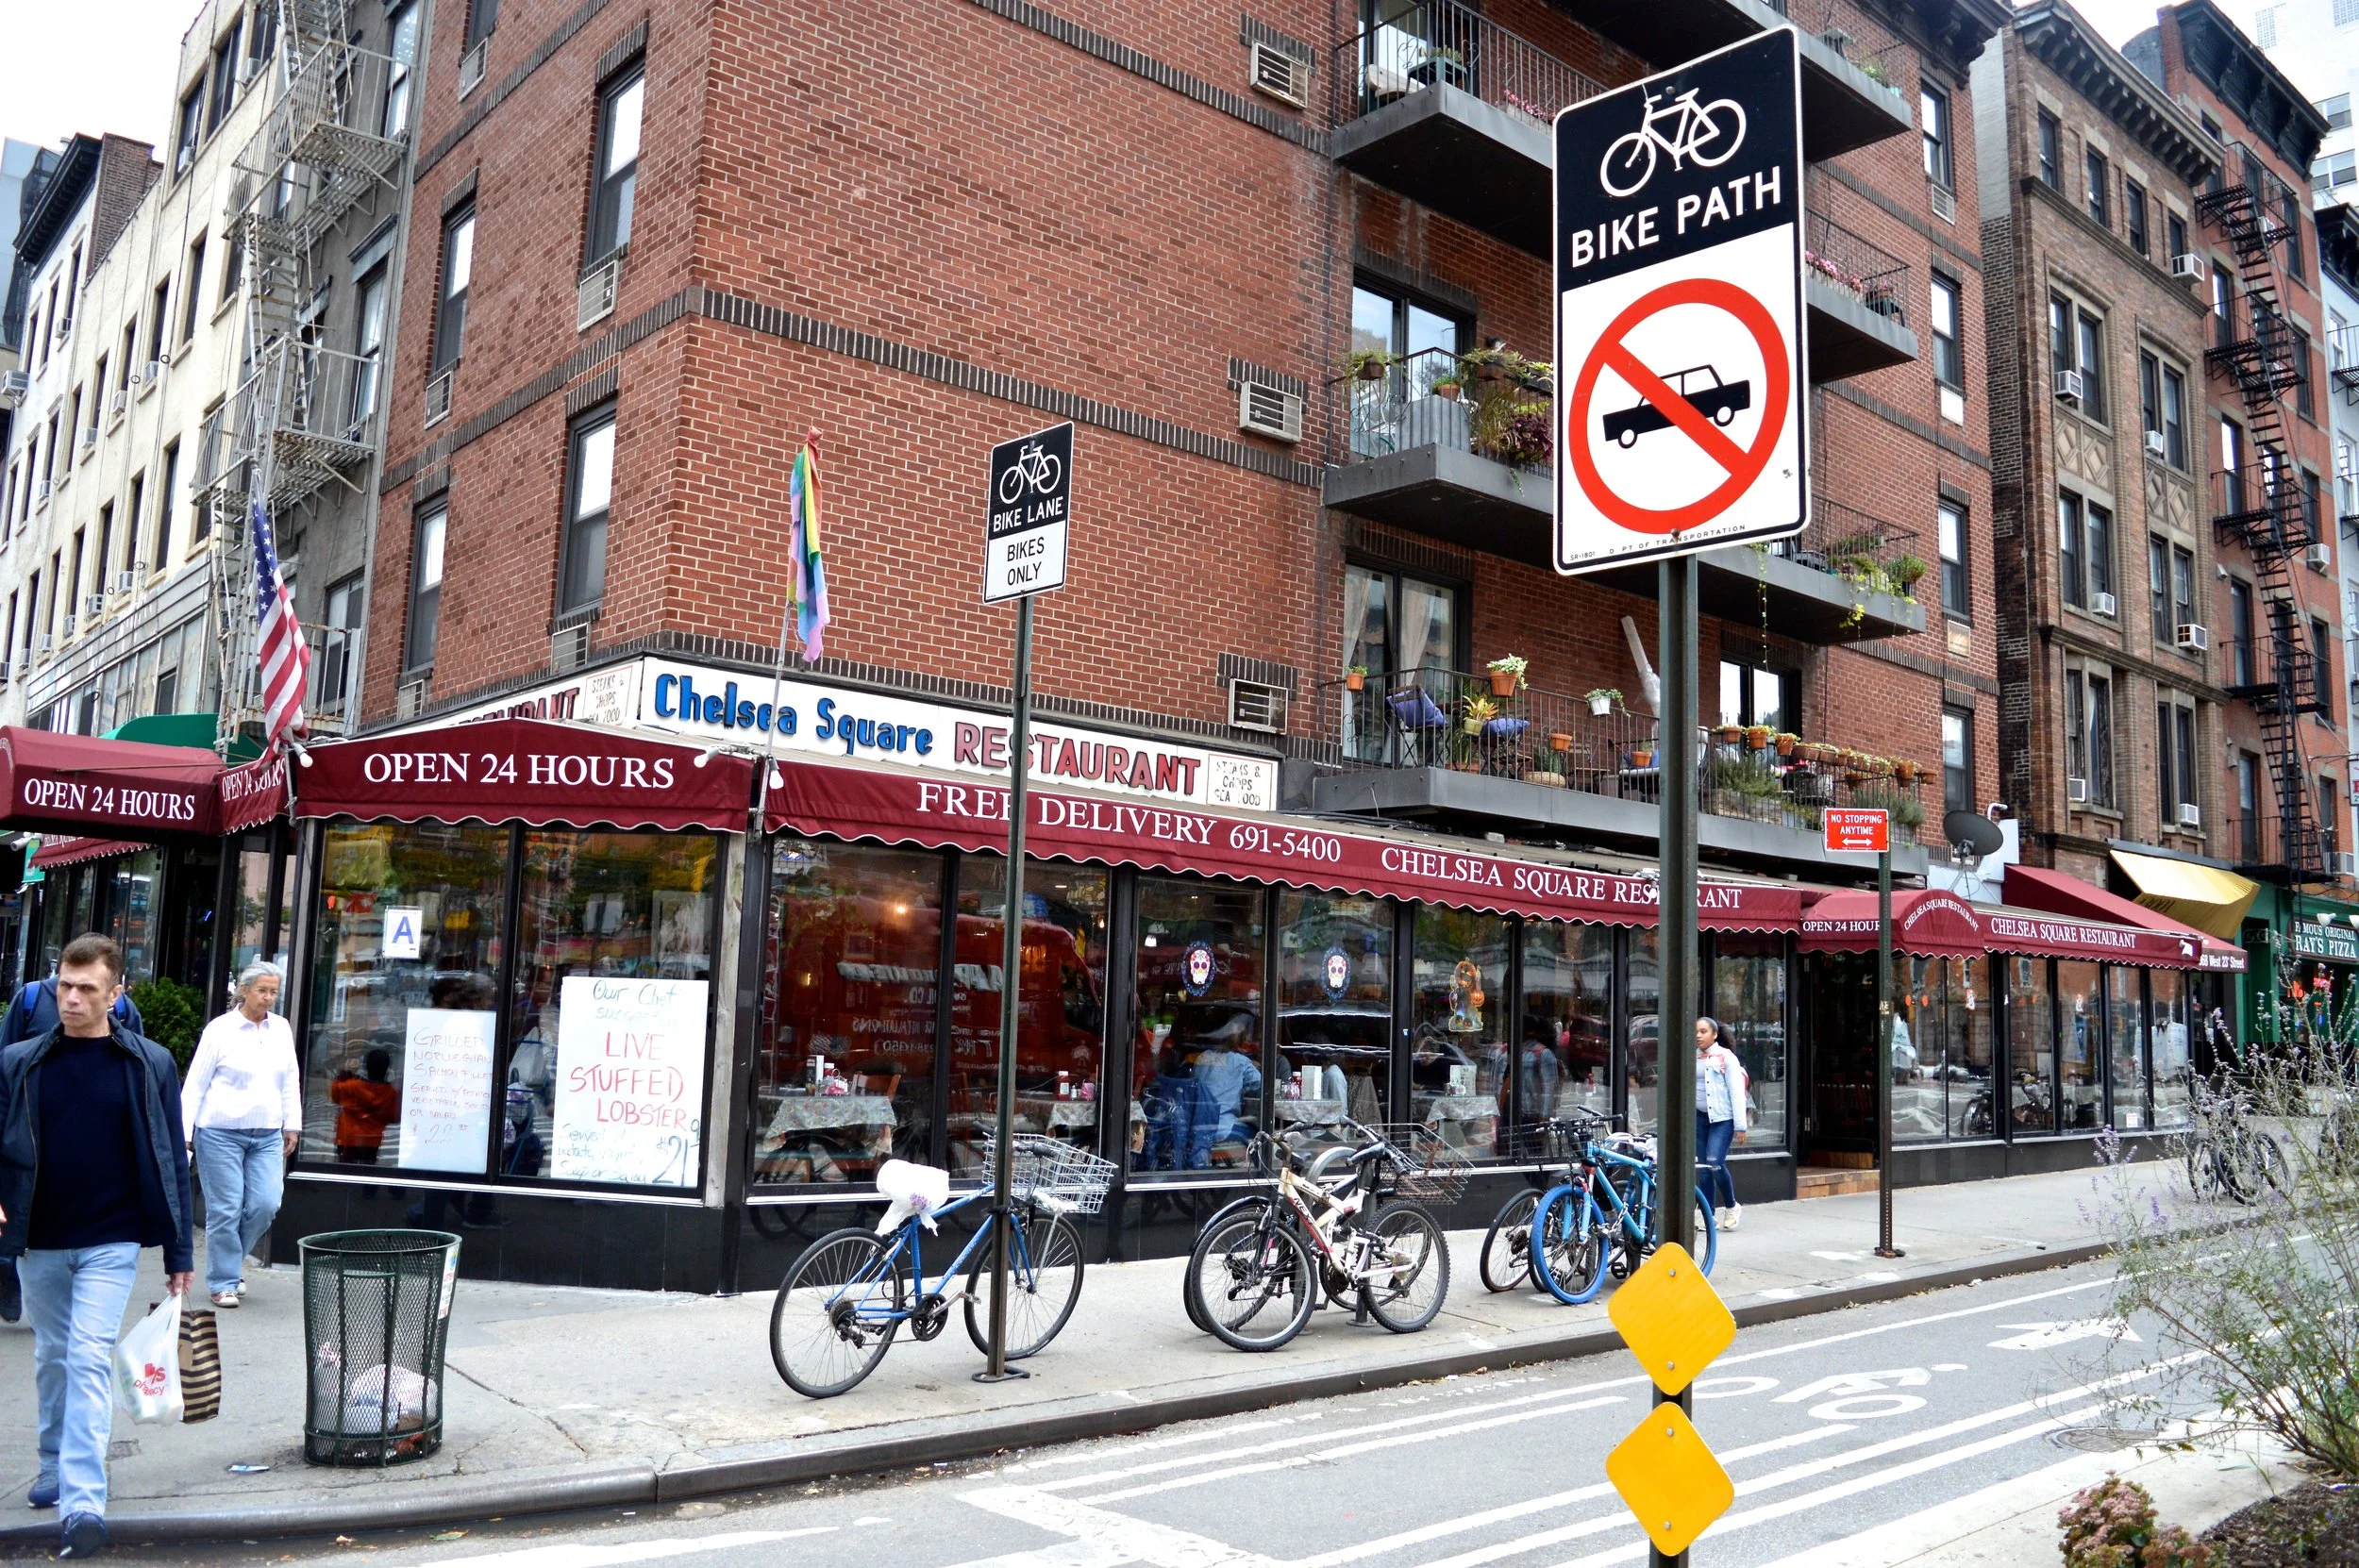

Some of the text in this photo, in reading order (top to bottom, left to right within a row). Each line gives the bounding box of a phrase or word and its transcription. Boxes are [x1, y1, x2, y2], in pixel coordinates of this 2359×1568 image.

[1572, 166, 1782, 269] BIKE PATH
[994, 496, 1063, 532] BIKE LANE
[1007, 536, 1045, 562] BIKES
[1609, 545, 1633, 555] DPT
[1656, 525, 1746, 545] TRANSPORTATION
[1570, 551, 1596, 560] SR-1801
[1007, 561, 1042, 586] ONLY
[655, 673, 797, 735] Chelsea
[815, 697, 934, 757] Square
[364, 753, 675, 790] OPEN 24 HOURS
[1254, 766, 1261, 777] &
[25, 777, 195, 821] OPEN 24 HOURS
[222, 771, 243, 802] OPEN
[1238, 792, 1261, 807] OOD
[1831, 814, 1882, 824] NO STOPPING
[1840, 826, 1873, 835] ANYTIME
[1038, 796, 1217, 844] DELIVERY
[1230, 825, 1342, 862] 691-5400
[1381, 847, 1504, 887] CHELSEA
[1514, 868, 1606, 901] SQUARE
[1614, 881, 1742, 909] RESANT
[1802, 921, 1832, 932] OPEN
[1834, 921, 1847, 932] 24
[1904, 898, 1979, 932] CHELSEA SQUARE RESTAURANT
[392, 916, 414, 943] A
[1991, 918, 2135, 949] CHELSEA SQUARE RESTAURANT
[2325, 926, 2355, 941] ORIGINAL
[2295, 935, 2356, 959] RAY'S PIZZA
[2209, 955, 2220, 967] West
[2230, 956, 2244, 968] Street
[413, 1027, 484, 1047] GRILLED
[606, 1031, 664, 1060] LIVE
[413, 1051, 492, 1064] NORWEGIAN
[570, 1064, 684, 1103] STUFFED
[596, 1097, 687, 1132] LOBSTER
